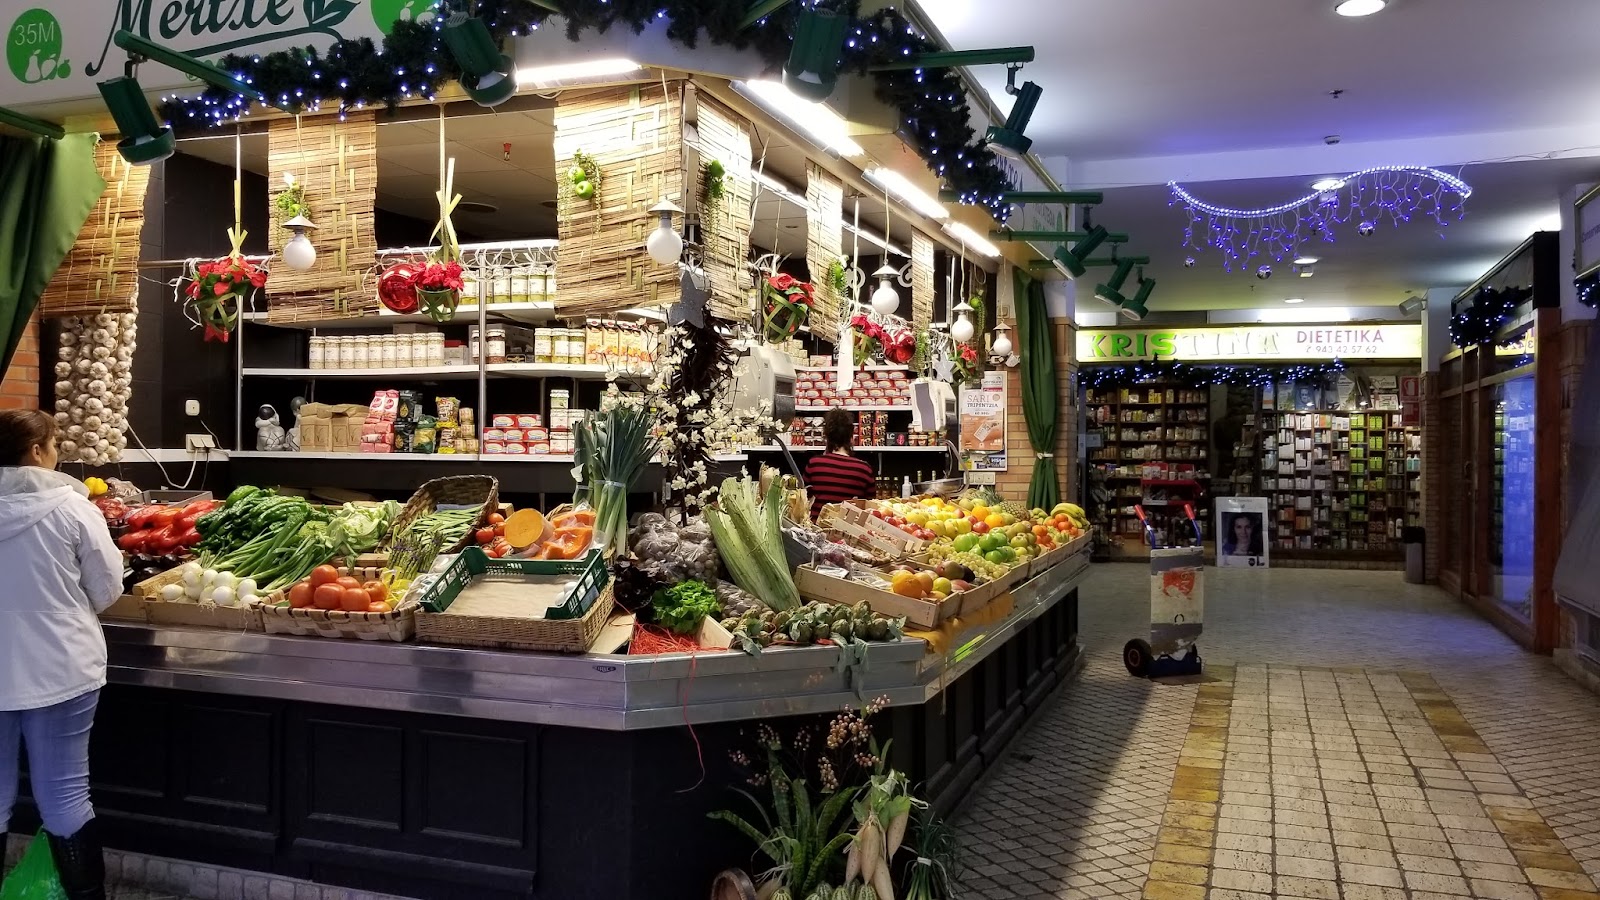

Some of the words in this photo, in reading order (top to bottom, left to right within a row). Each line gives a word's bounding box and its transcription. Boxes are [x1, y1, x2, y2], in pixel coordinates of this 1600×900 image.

[14, 21, 54, 46] 35M
[1296, 329, 1385, 344] DIETETIKA
[1088, 331, 1281, 358] KRISTINA
[1315, 345, 1333, 354] 943
[1336, 345, 1348, 354] 42
[1351, 345, 1362, 354] 57
[1365, 345, 1378, 354] 62
[967, 394, 990, 403] SARI
